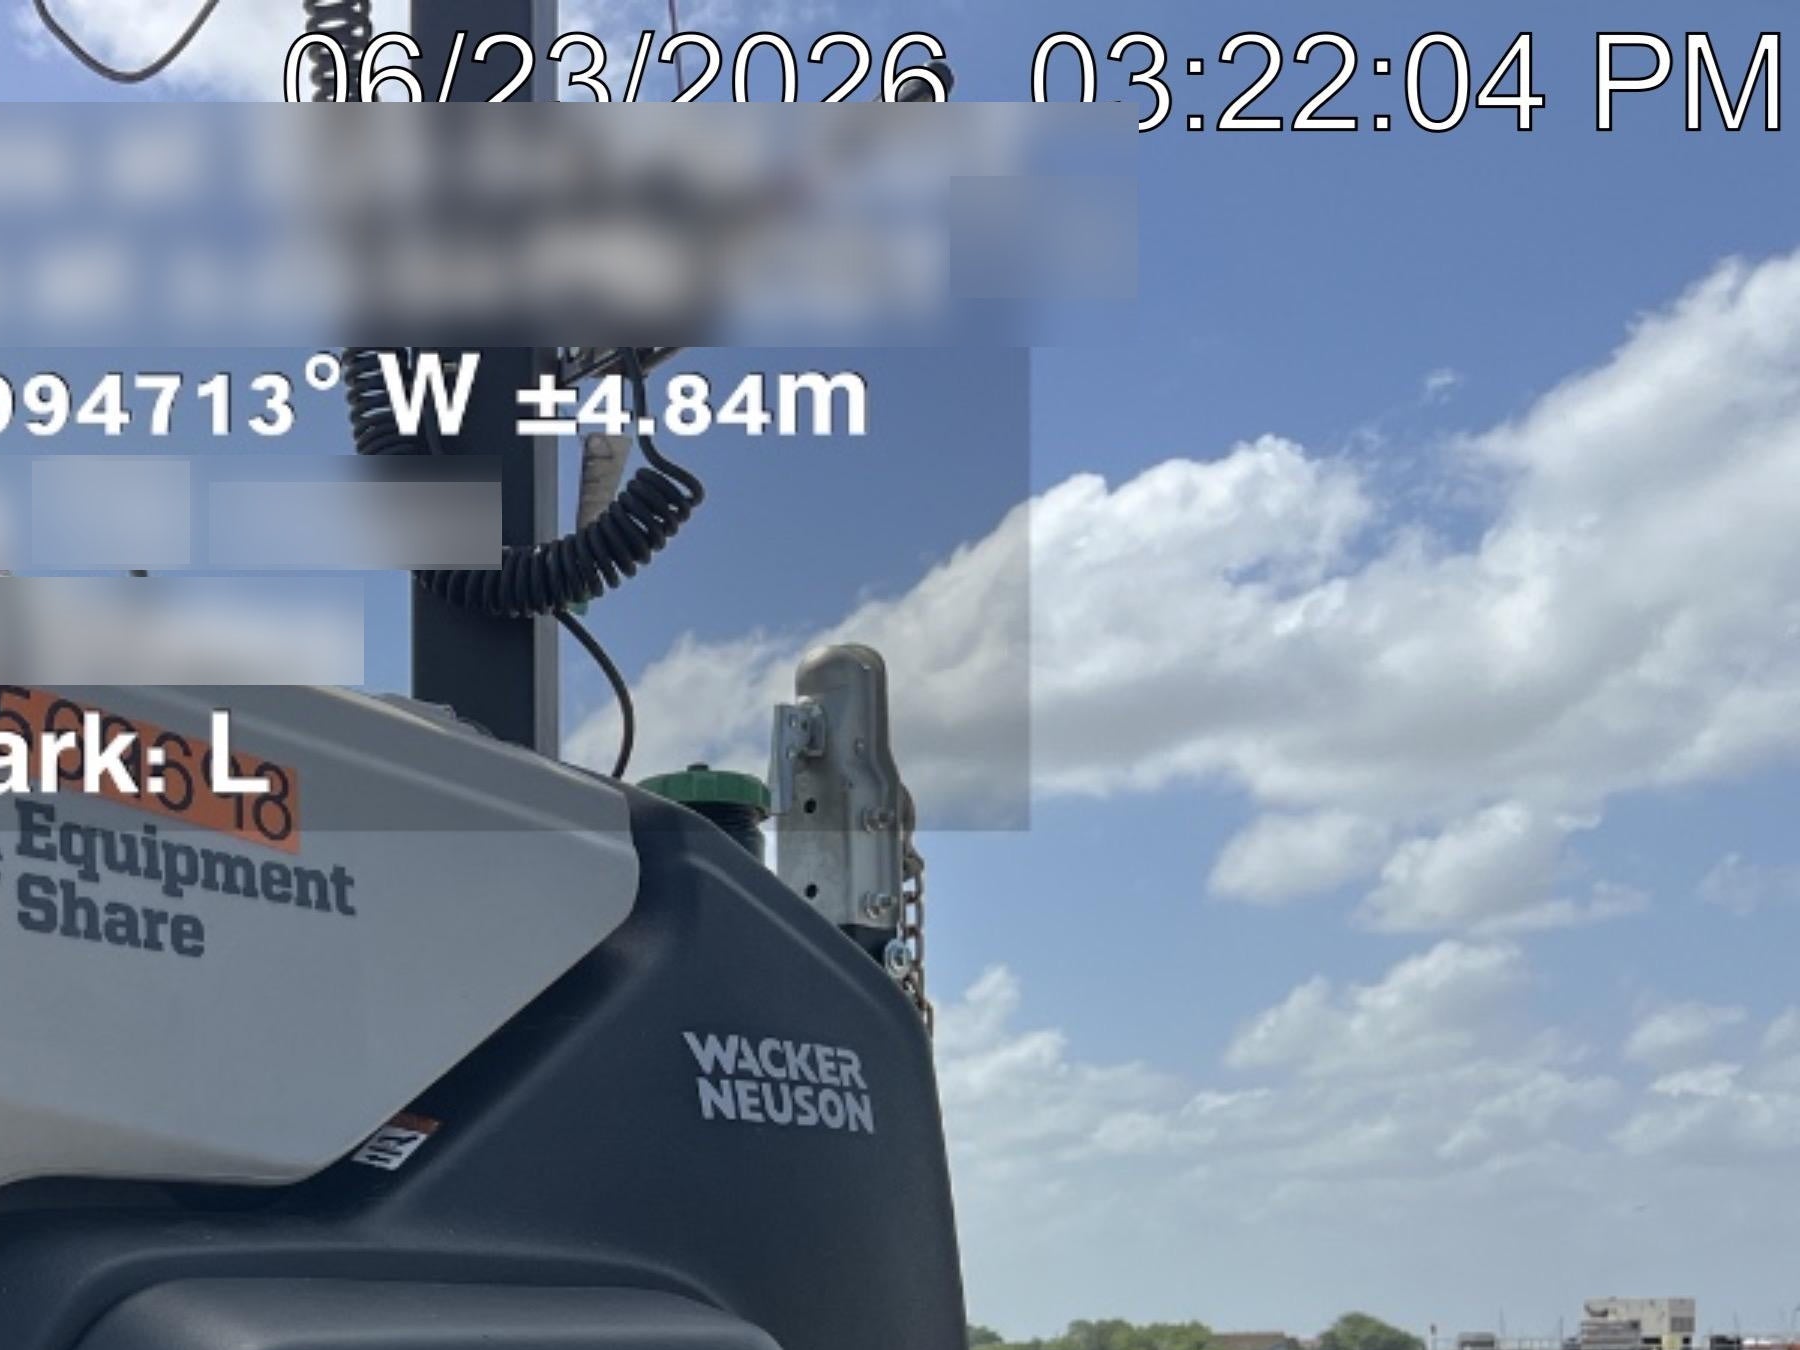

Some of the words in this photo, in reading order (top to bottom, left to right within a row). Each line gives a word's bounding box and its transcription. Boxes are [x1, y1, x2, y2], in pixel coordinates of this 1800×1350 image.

[15, 798, 357, 916] Equipment
[16, 872, 205, 957] Share
[682, 1031, 868, 1090] WACKER
[696, 1076, 875, 1135] NEUSON
